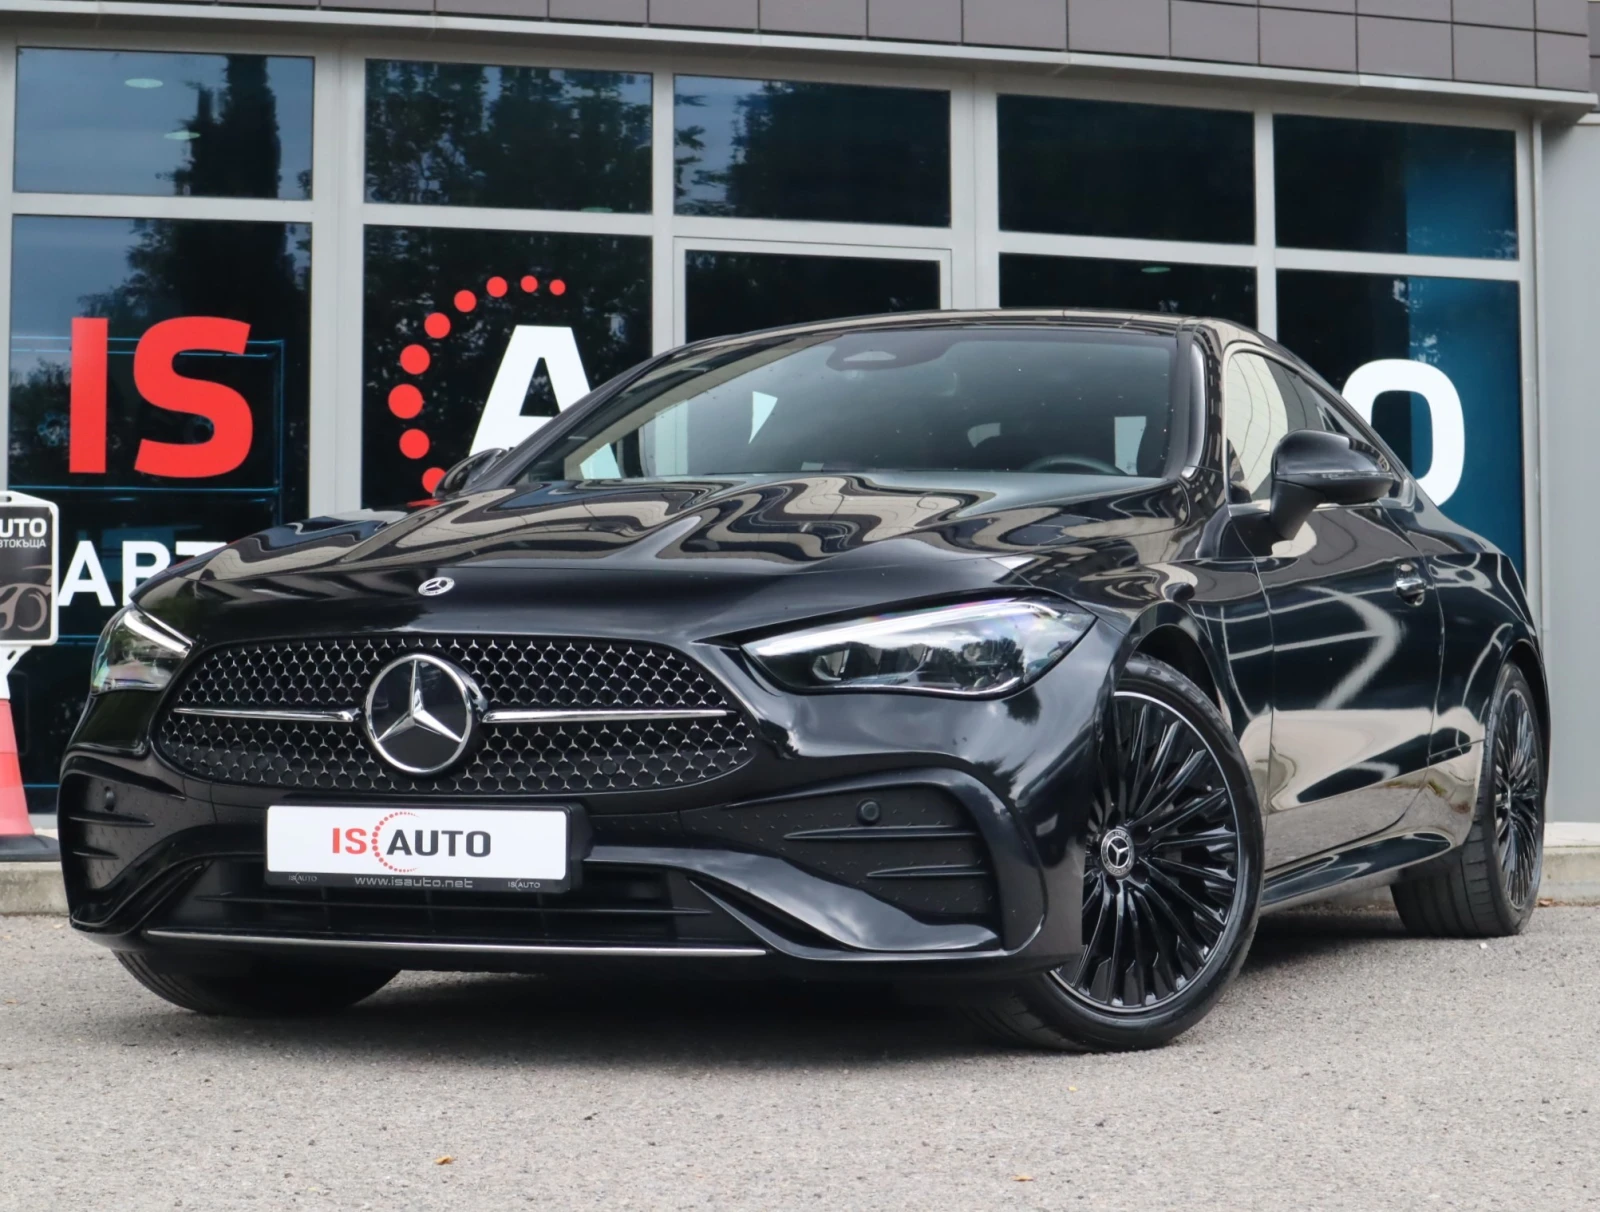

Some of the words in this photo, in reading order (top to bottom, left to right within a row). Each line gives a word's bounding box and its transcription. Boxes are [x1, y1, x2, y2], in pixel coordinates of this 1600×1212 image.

[69, 315, 254, 478] IS
[331, 827, 368, 855] IS
[386, 828, 492, 857] AUTO
[354, 876, 474, 889] www.isauto.net
[517, 881, 541, 889] AUTO
